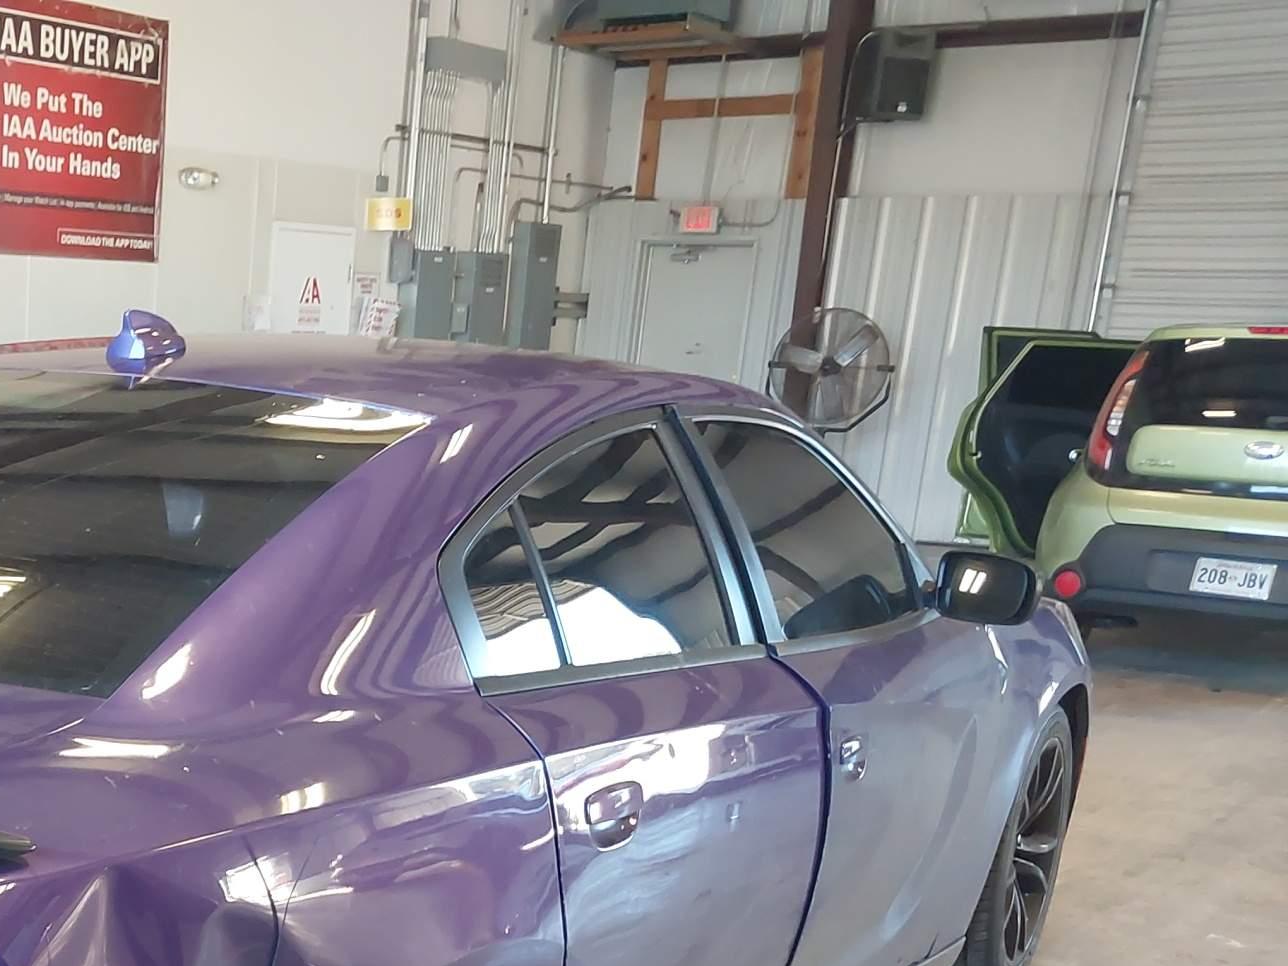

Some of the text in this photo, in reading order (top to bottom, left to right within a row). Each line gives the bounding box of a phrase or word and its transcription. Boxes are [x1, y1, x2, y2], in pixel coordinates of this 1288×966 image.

[40, 24, 110, 69] BUYER
[115, 38, 155, 75] APP
[3, 82, 103, 118] We Put The
[2, 113, 159, 155] IAA Auction Center
[2, 144, 121, 180] In Your Hands
[61, 234, 101, 246] DOWNLOAD
[1197, 567, 1268, 590] 208 JBV
